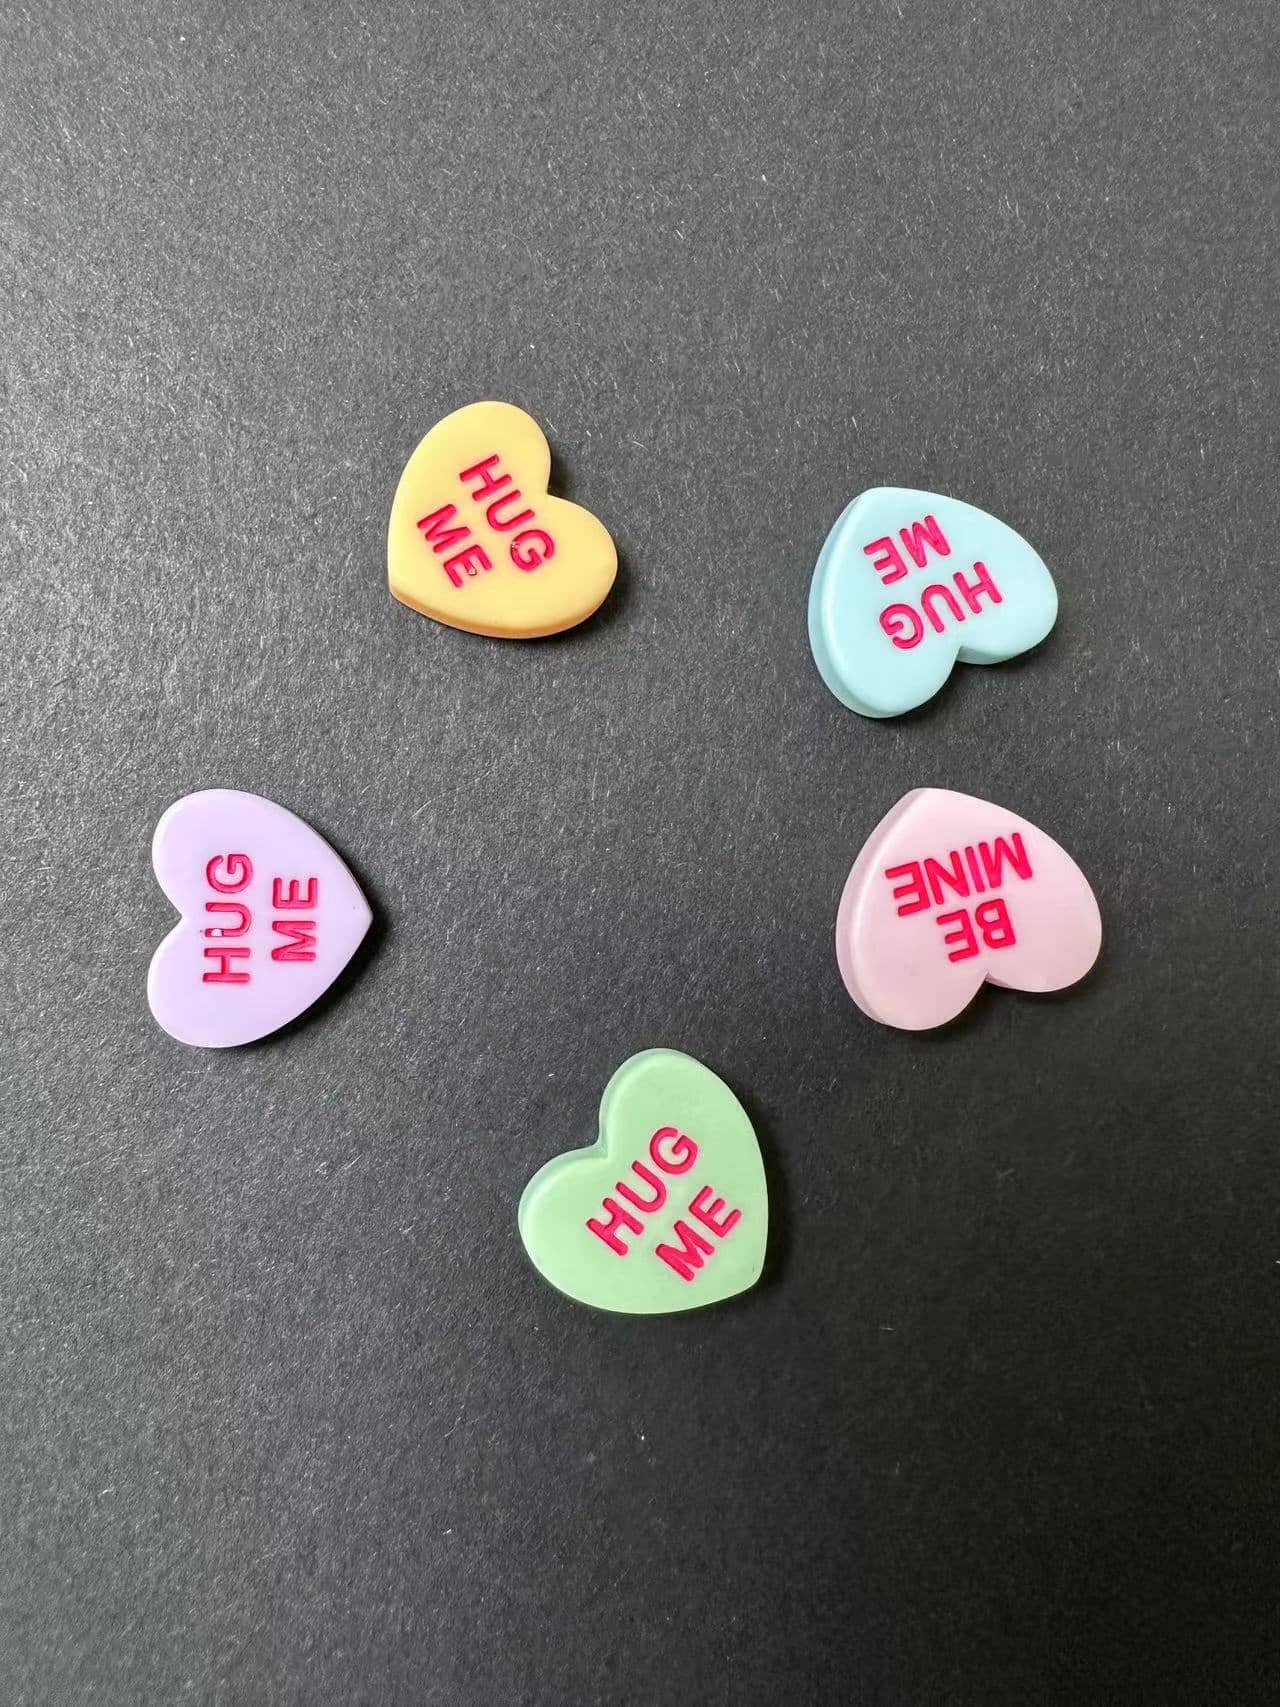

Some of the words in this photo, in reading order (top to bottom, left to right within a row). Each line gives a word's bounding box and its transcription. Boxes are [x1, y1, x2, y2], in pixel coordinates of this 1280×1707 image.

[417, 503, 495, 589] ME
[458, 454, 557, 573] HUG
[863, 515, 952, 586] ME
[879, 560, 1004, 651] HUG
[201, 851, 255, 987] HUG
[269, 875, 321, 965] ME
[882, 831, 1035, 920] MINE
[933, 896, 1019, 966] BE
[586, 1126, 700, 1258] HUG
[655, 1186, 742, 1283] ME
